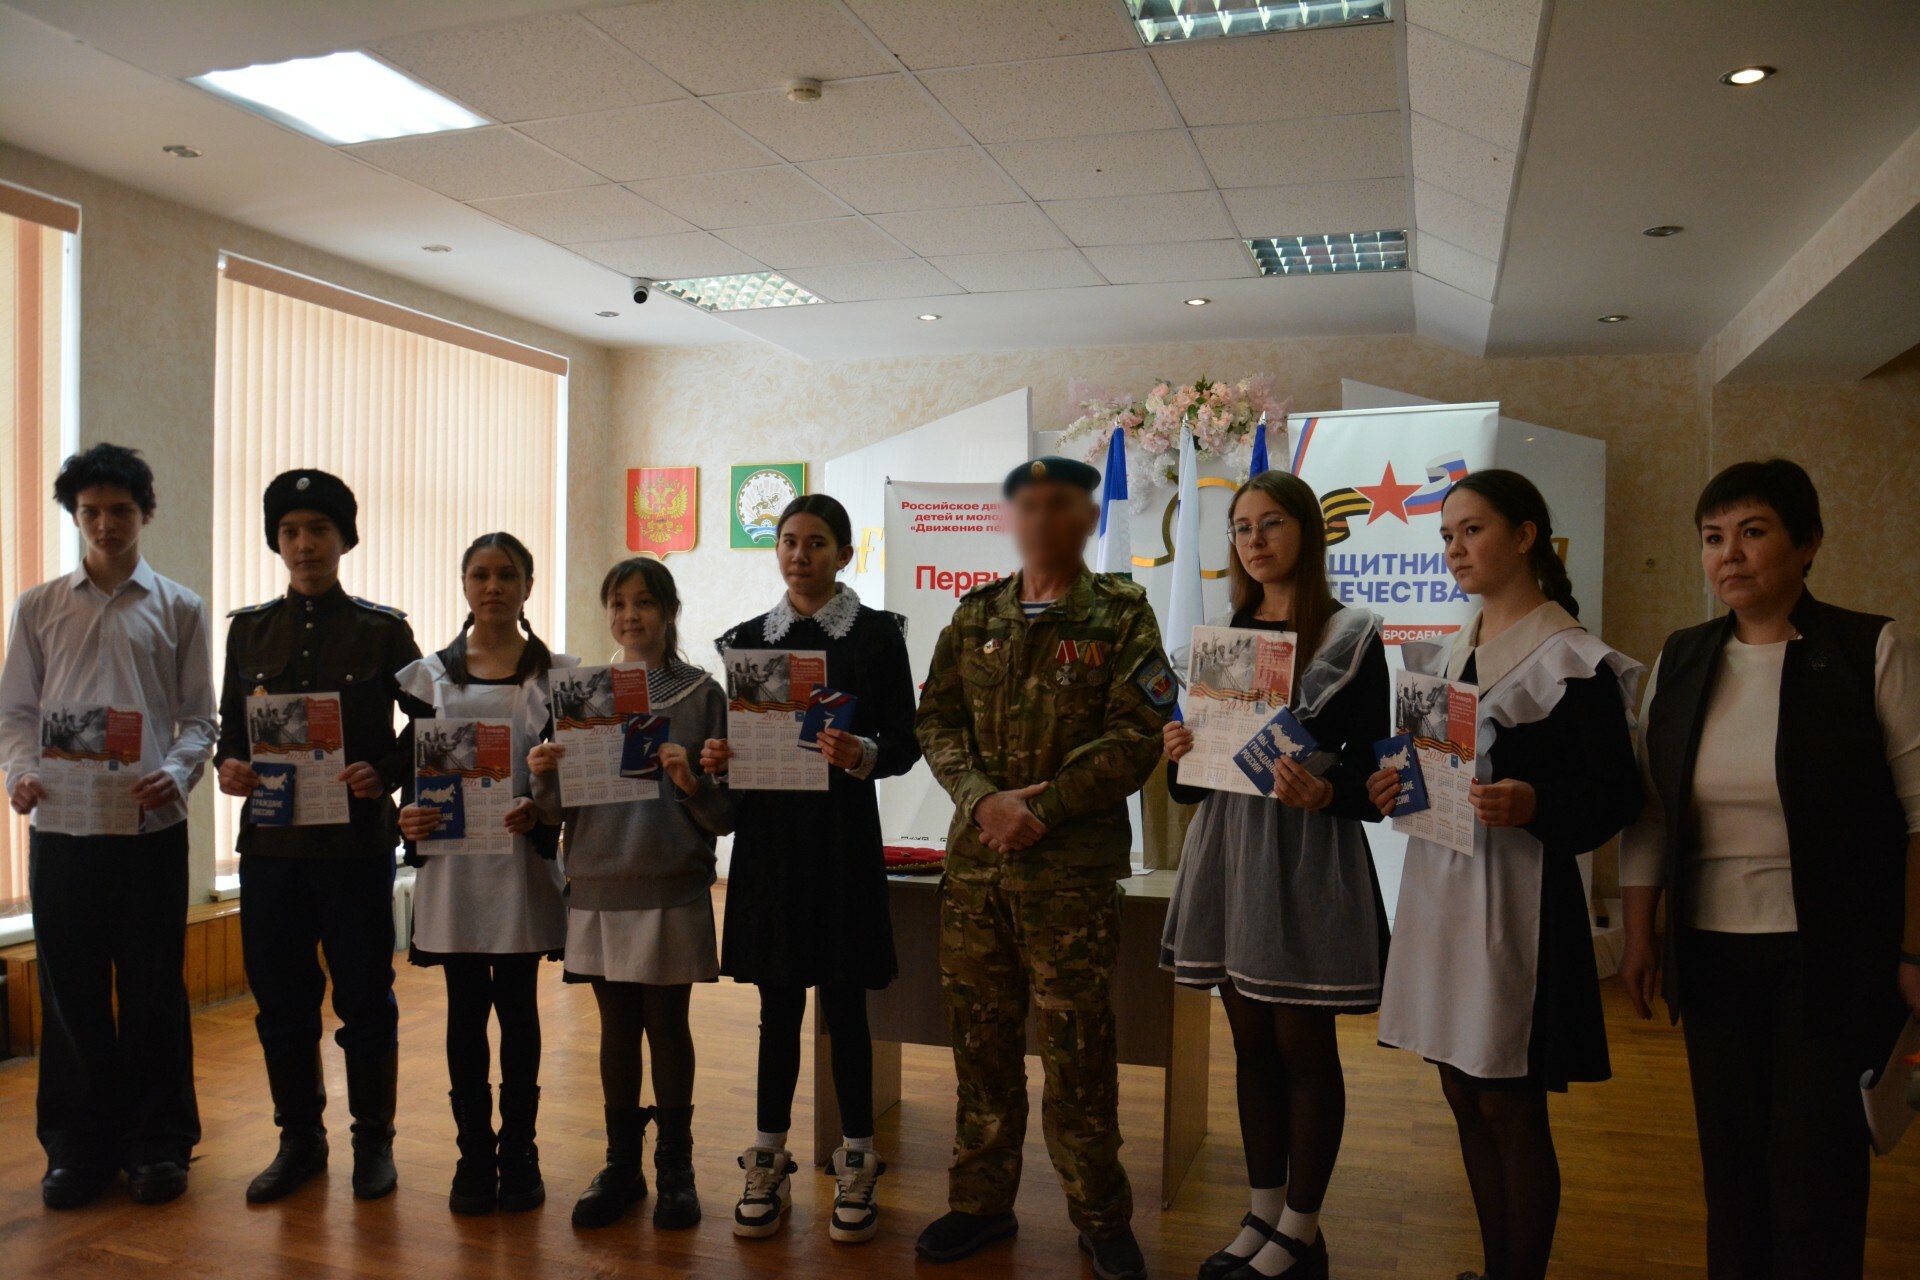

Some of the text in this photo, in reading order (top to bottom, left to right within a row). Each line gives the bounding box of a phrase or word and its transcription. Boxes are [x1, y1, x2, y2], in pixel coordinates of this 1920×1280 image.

[901, 501, 979, 511] Российское
[915, 512, 952, 522] детей
[910, 523, 983, 533] «Движение
[1328, 553, 1447, 577] ЩИТНИ
[763, 711, 791, 721] 2026
[590, 726, 617, 736] 2026
[1256, 733, 1271, 747] МЫ
[1424, 749, 1447, 763] 2026
[1240, 748, 1264, 775] РОССИИ!
[464, 779, 477, 787] 26
